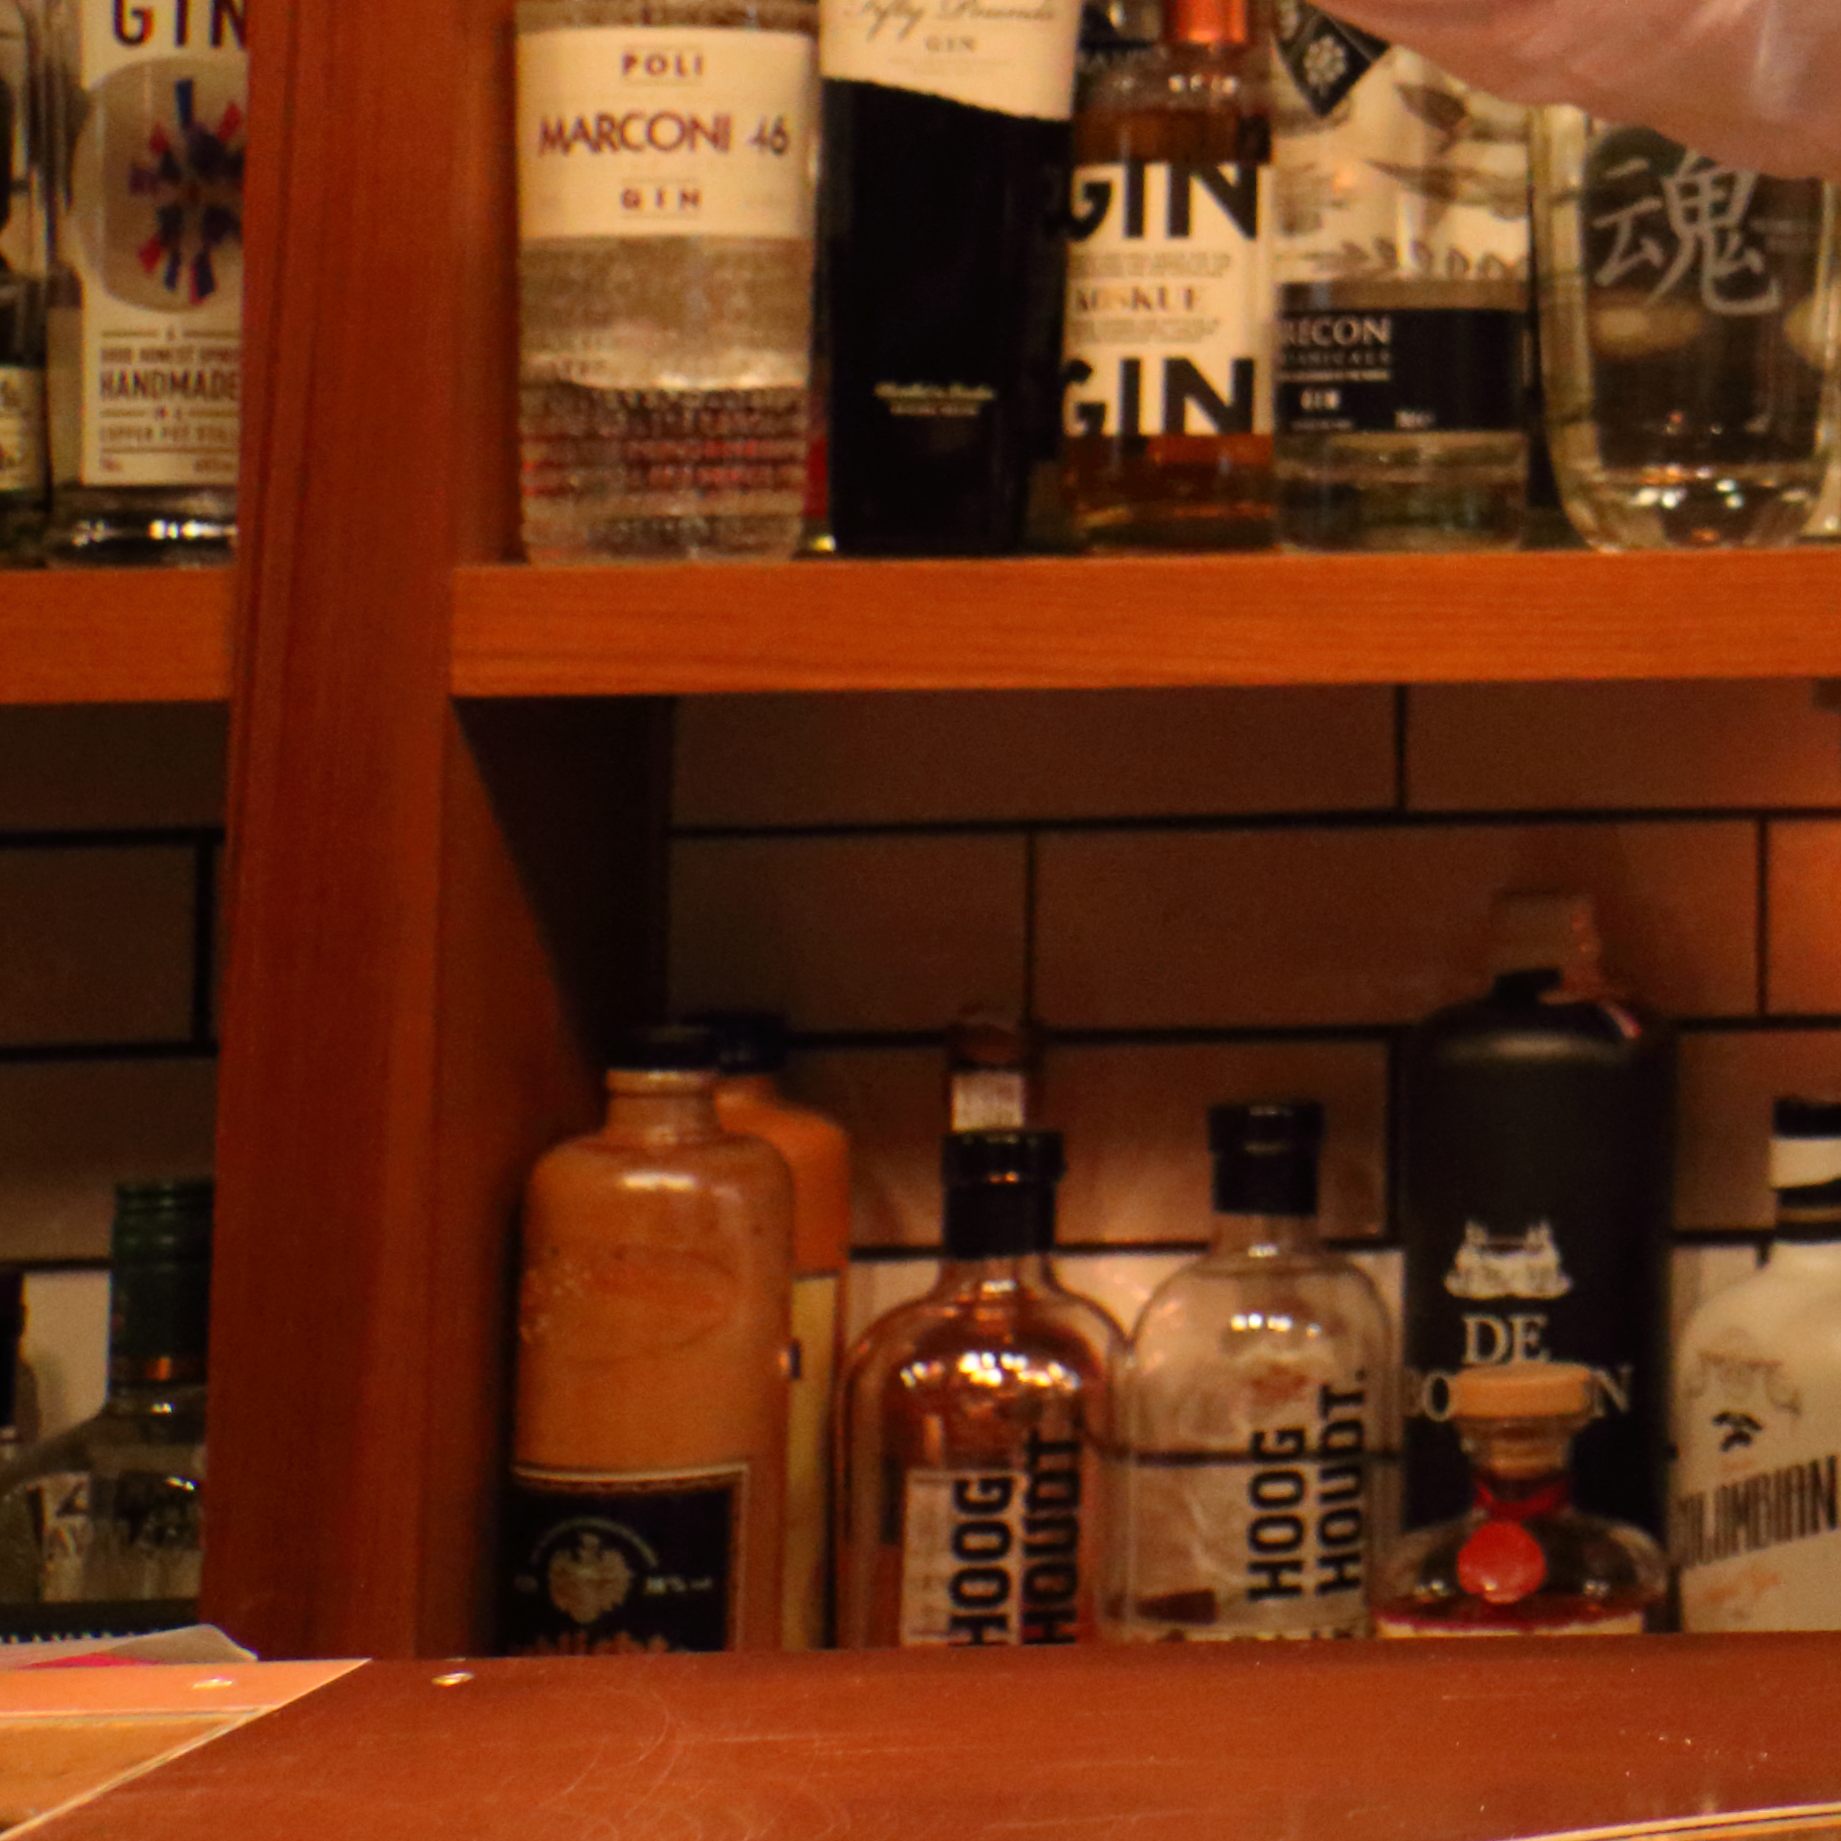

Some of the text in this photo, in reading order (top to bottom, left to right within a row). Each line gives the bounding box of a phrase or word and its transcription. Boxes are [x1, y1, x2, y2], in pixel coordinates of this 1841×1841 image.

[621, 53, 705, 77] POLI
[538, 111, 789, 157] MARCONI 46
[620, 185, 701, 211] GIN
[1592, 151, 1782, 317] 魂
[100, 370, 240, 400] HANDMADE
[1062, 356, 1258, 437] GIN
[1463, 1314, 1547, 1363] DE
[1246, 1427, 1306, 1602] HOOG
[948, 1476, 1014, 1646] HOOG
